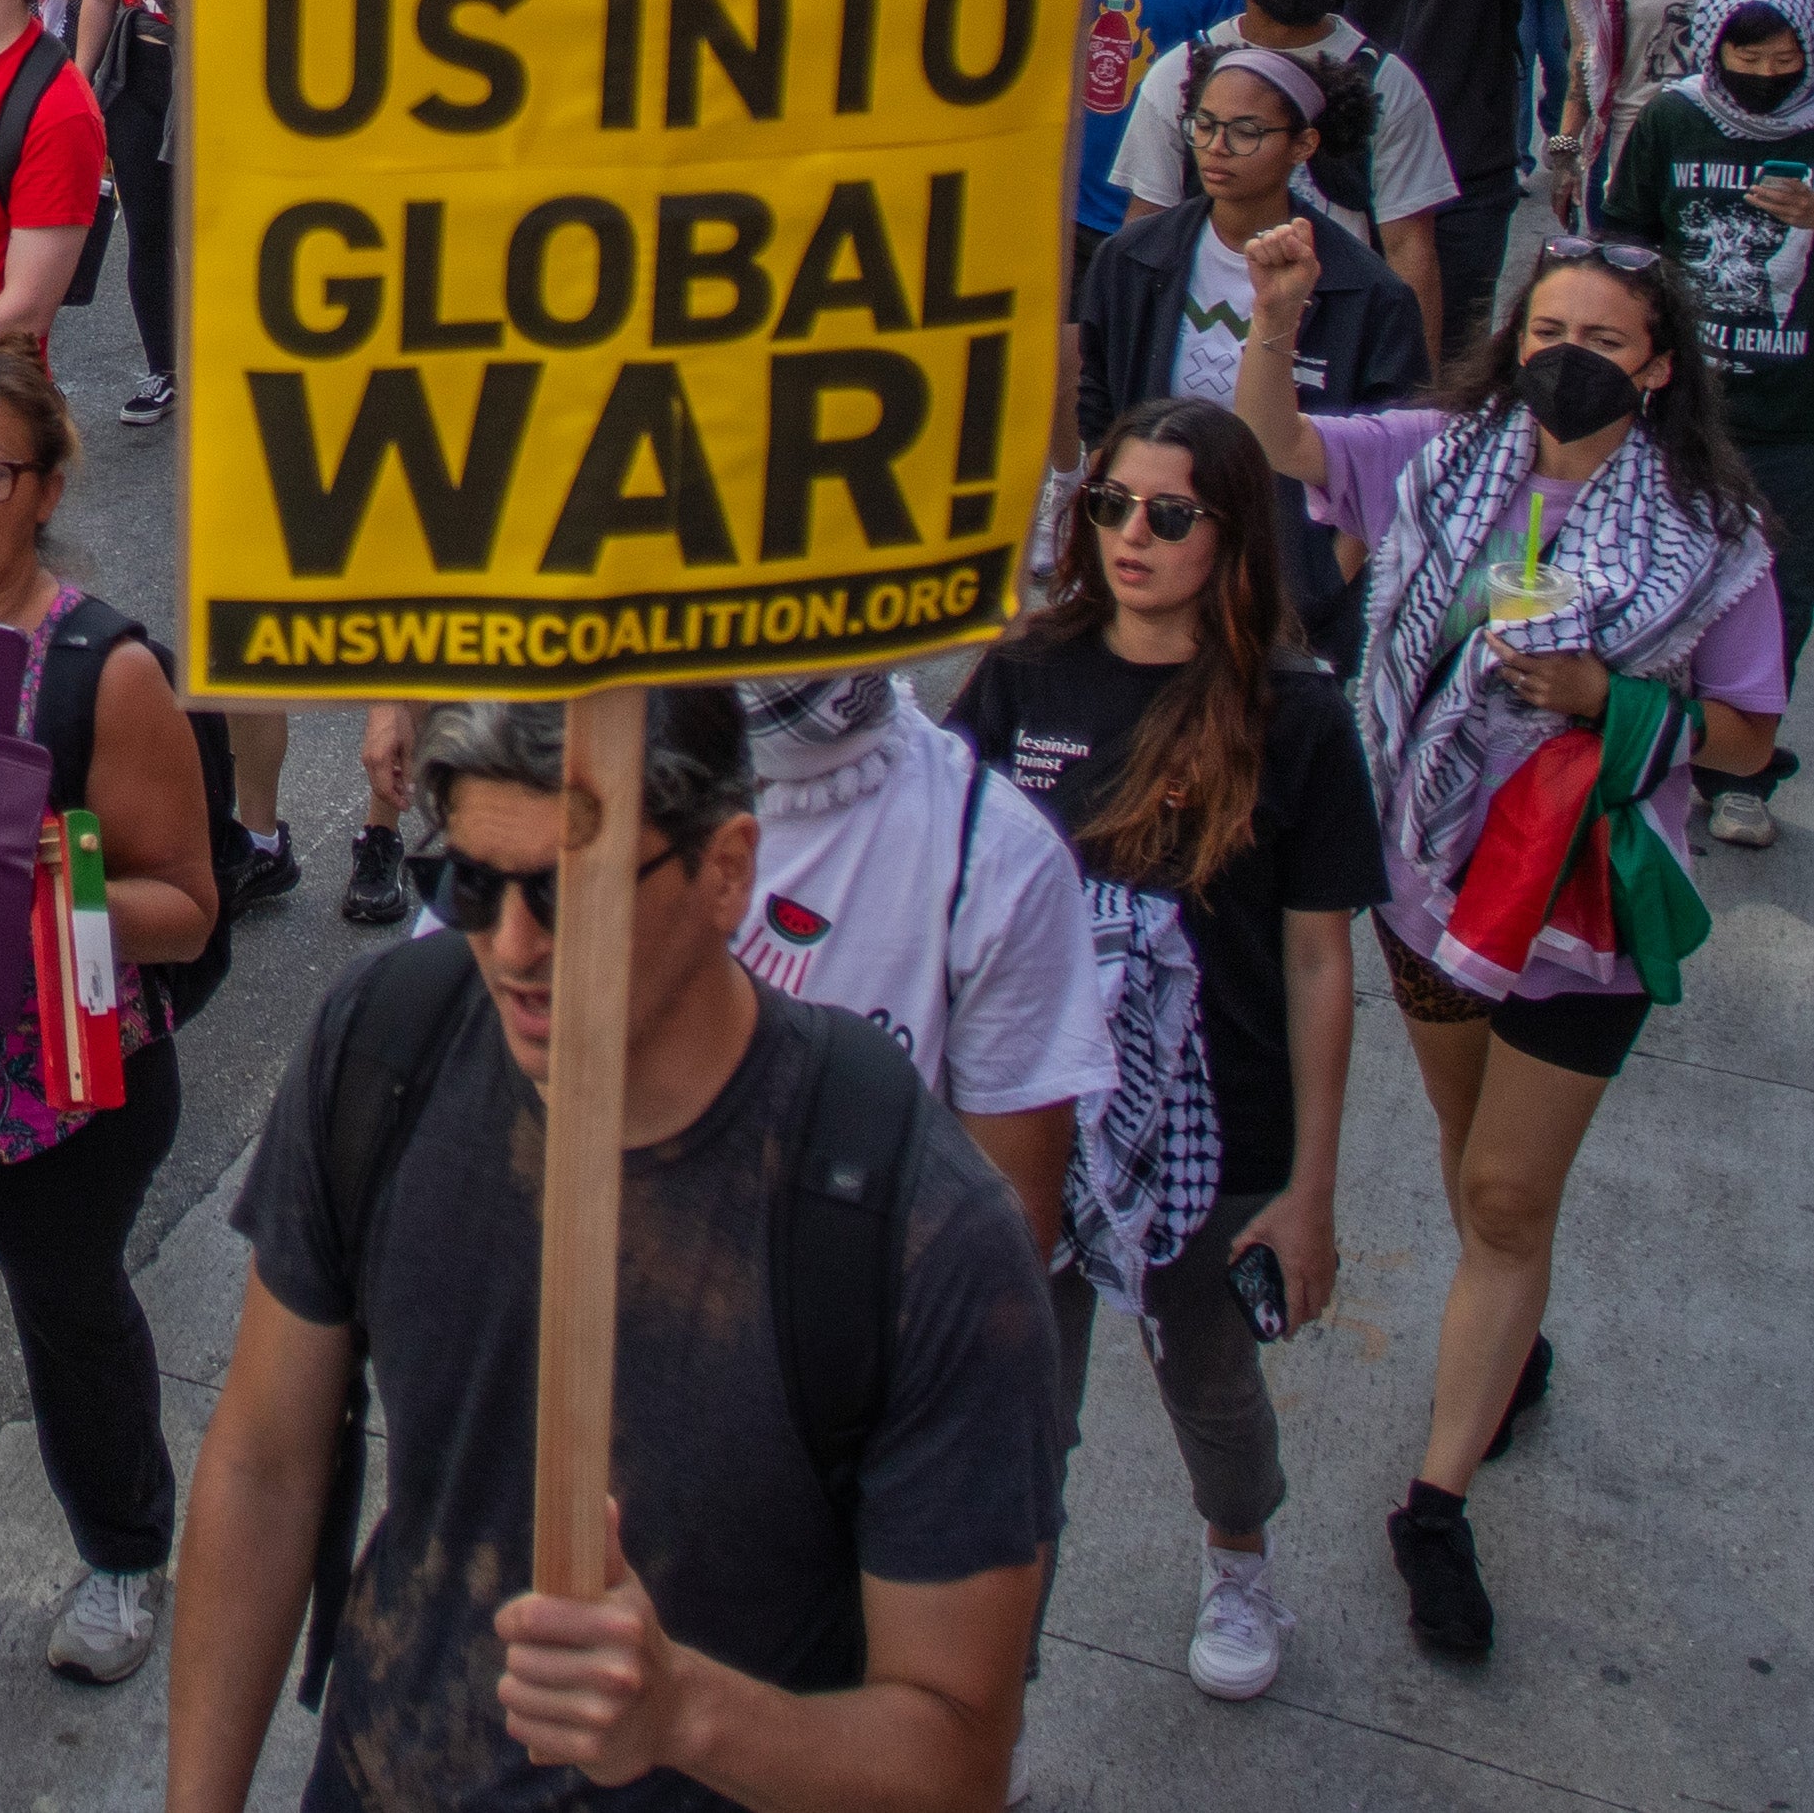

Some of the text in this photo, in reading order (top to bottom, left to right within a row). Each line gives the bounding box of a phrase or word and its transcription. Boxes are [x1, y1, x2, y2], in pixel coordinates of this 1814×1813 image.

[1673, 163, 1748, 190] WE WILL
[254, 170, 1015, 361] GLOBAL
[1733, 327, 1808, 355] REMAIN
[245, 329, 1012, 579] WAR!
[243, 567, 980, 667] ANSWERCOALITION.ORG
